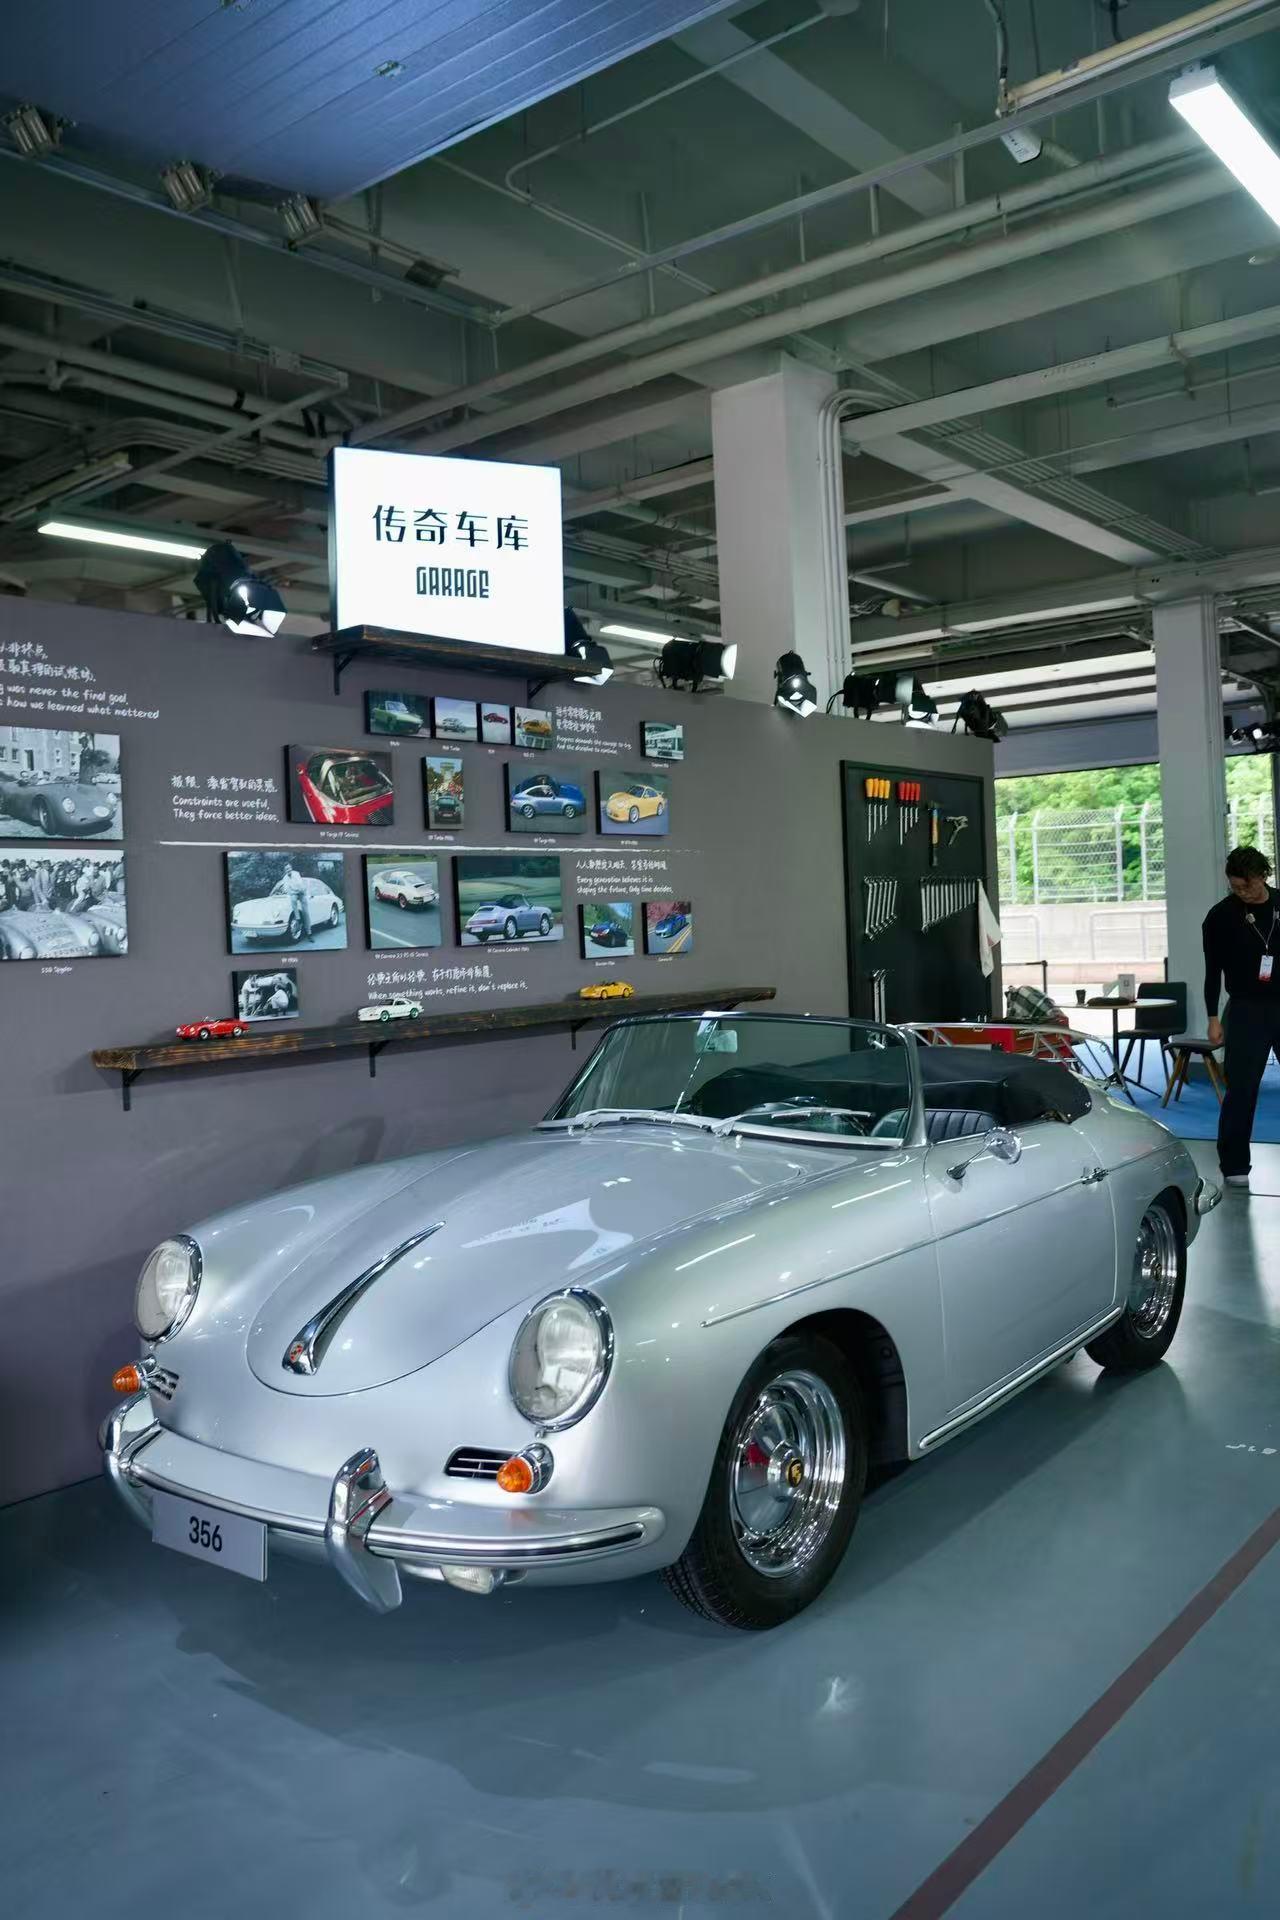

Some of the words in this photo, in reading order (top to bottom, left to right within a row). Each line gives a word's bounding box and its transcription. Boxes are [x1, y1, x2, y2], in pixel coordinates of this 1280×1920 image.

[372, 504, 529, 550] 传奇车库
[416, 566, 489, 599] GARAGE
[7, 685, 26, 694] was
[29, 687, 57, 697] never
[61, 688, 80, 698] the
[82, 690, 106, 701] final
[7, 697, 27, 708] how
[30, 701, 44, 709] we
[48, 701, 84, 712] learned
[87, 705, 112, 716] what
[114, 709, 160, 719] mattered
[172, 795, 223, 807] Constraints
[225, 799, 239, 808] are
[173, 808, 196, 822] They
[198, 809, 222, 820] force
[225, 810, 253, 820] better
[577, 875, 593, 887] Every
[598, 885, 608, 893] the
[368, 991, 388, 1000] When
[388, 989, 424, 999] something
[445, 985, 467, 995] refine
[497, 982, 519, 992] replace
[188, 1516, 223, 1552] 356
